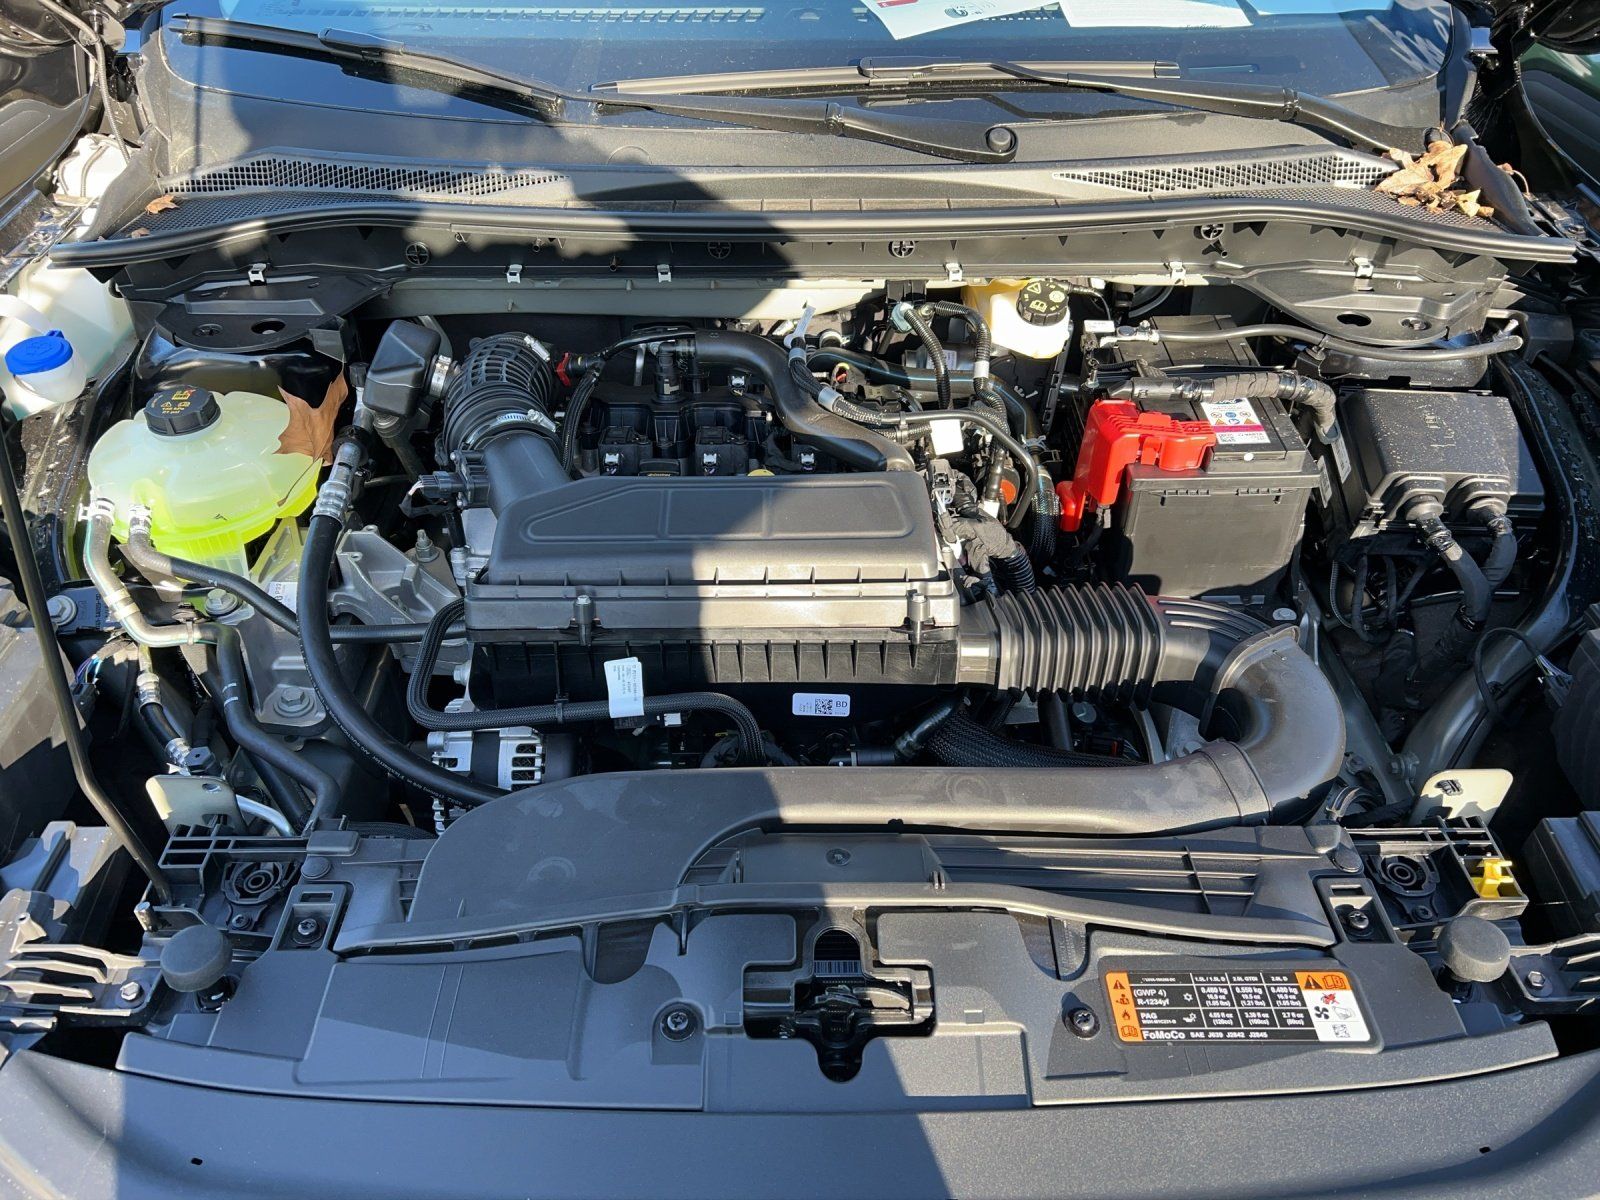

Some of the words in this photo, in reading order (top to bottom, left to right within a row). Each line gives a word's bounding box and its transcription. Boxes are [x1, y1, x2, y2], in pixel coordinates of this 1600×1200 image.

[835, 700, 848, 708] BD
[338, 723, 361, 748] SUCTION
[1133, 989, 1156, 997] (GWP
[1158, 989, 1166, 997] 4)
[1137, 998, 1169, 1006] R-1234yf
[1142, 1030, 1186, 1039] FoMoCo
